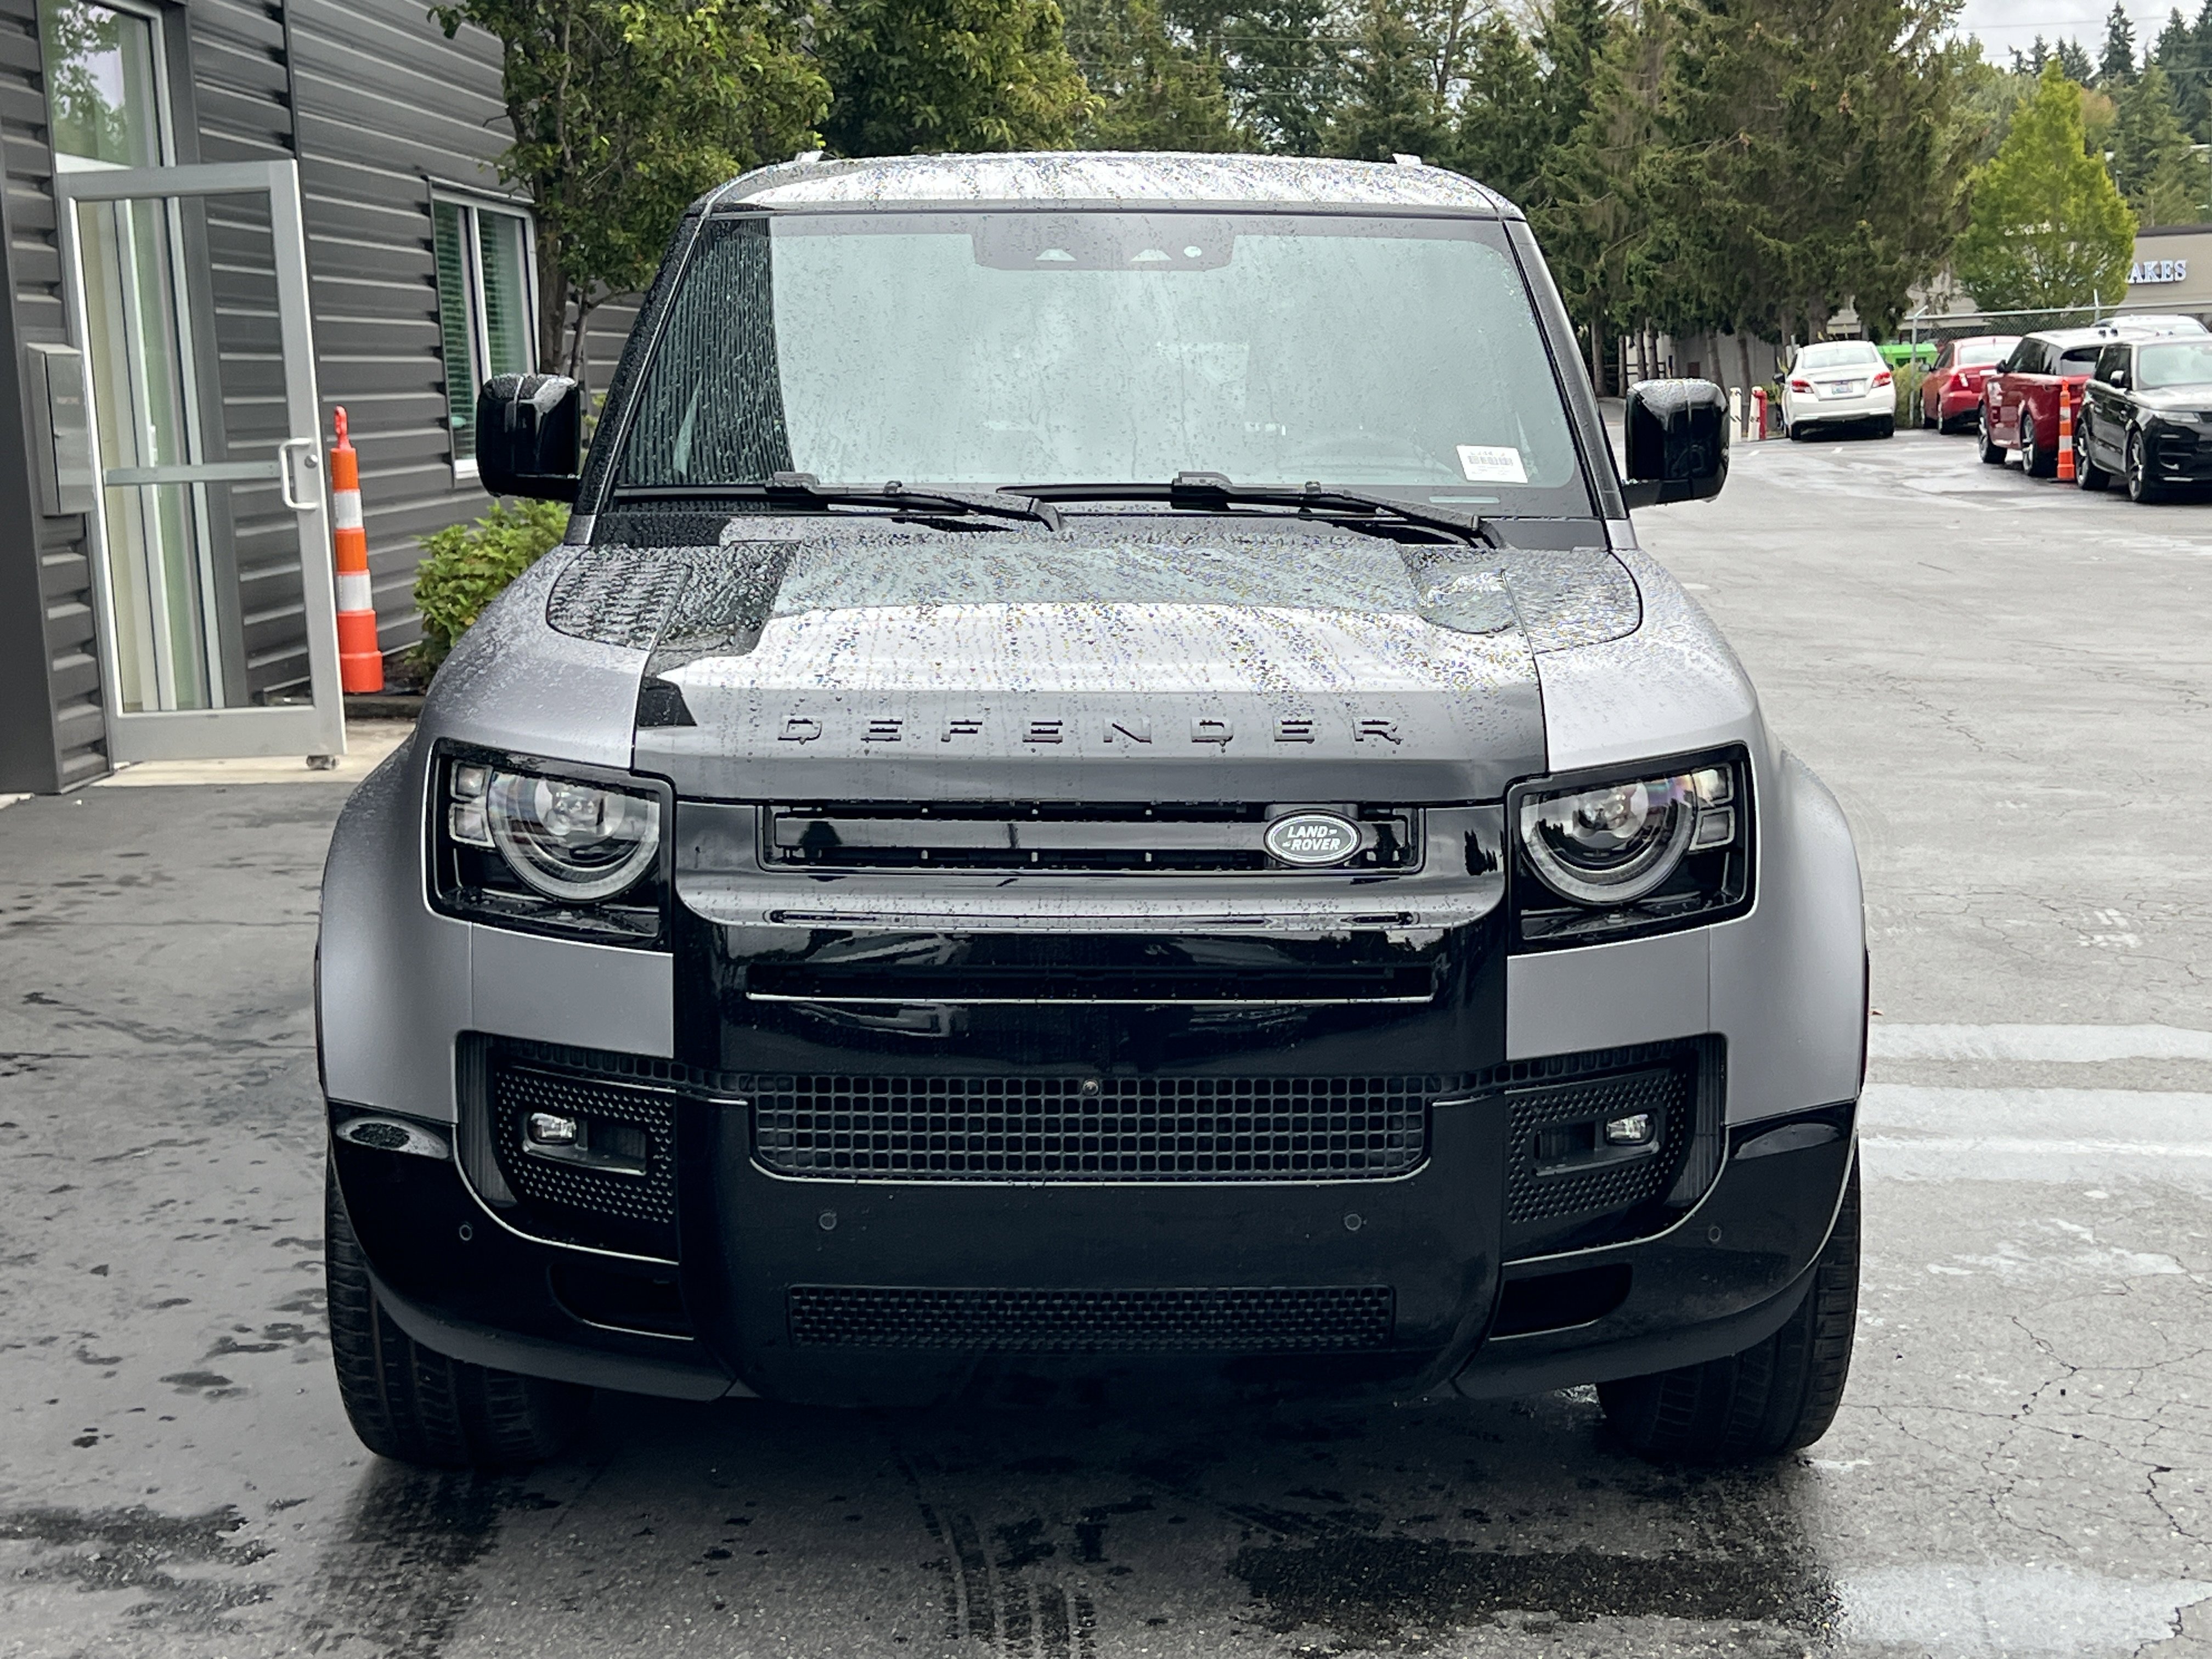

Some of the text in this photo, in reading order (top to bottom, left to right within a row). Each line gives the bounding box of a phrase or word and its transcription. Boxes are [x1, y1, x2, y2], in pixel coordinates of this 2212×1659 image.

[2125, 259, 2187, 284] AKES
[777, 715, 1404, 743] DEFENDER
[1287, 825, 1328, 838] LAND
[1290, 838, 1341, 850] ROVER
